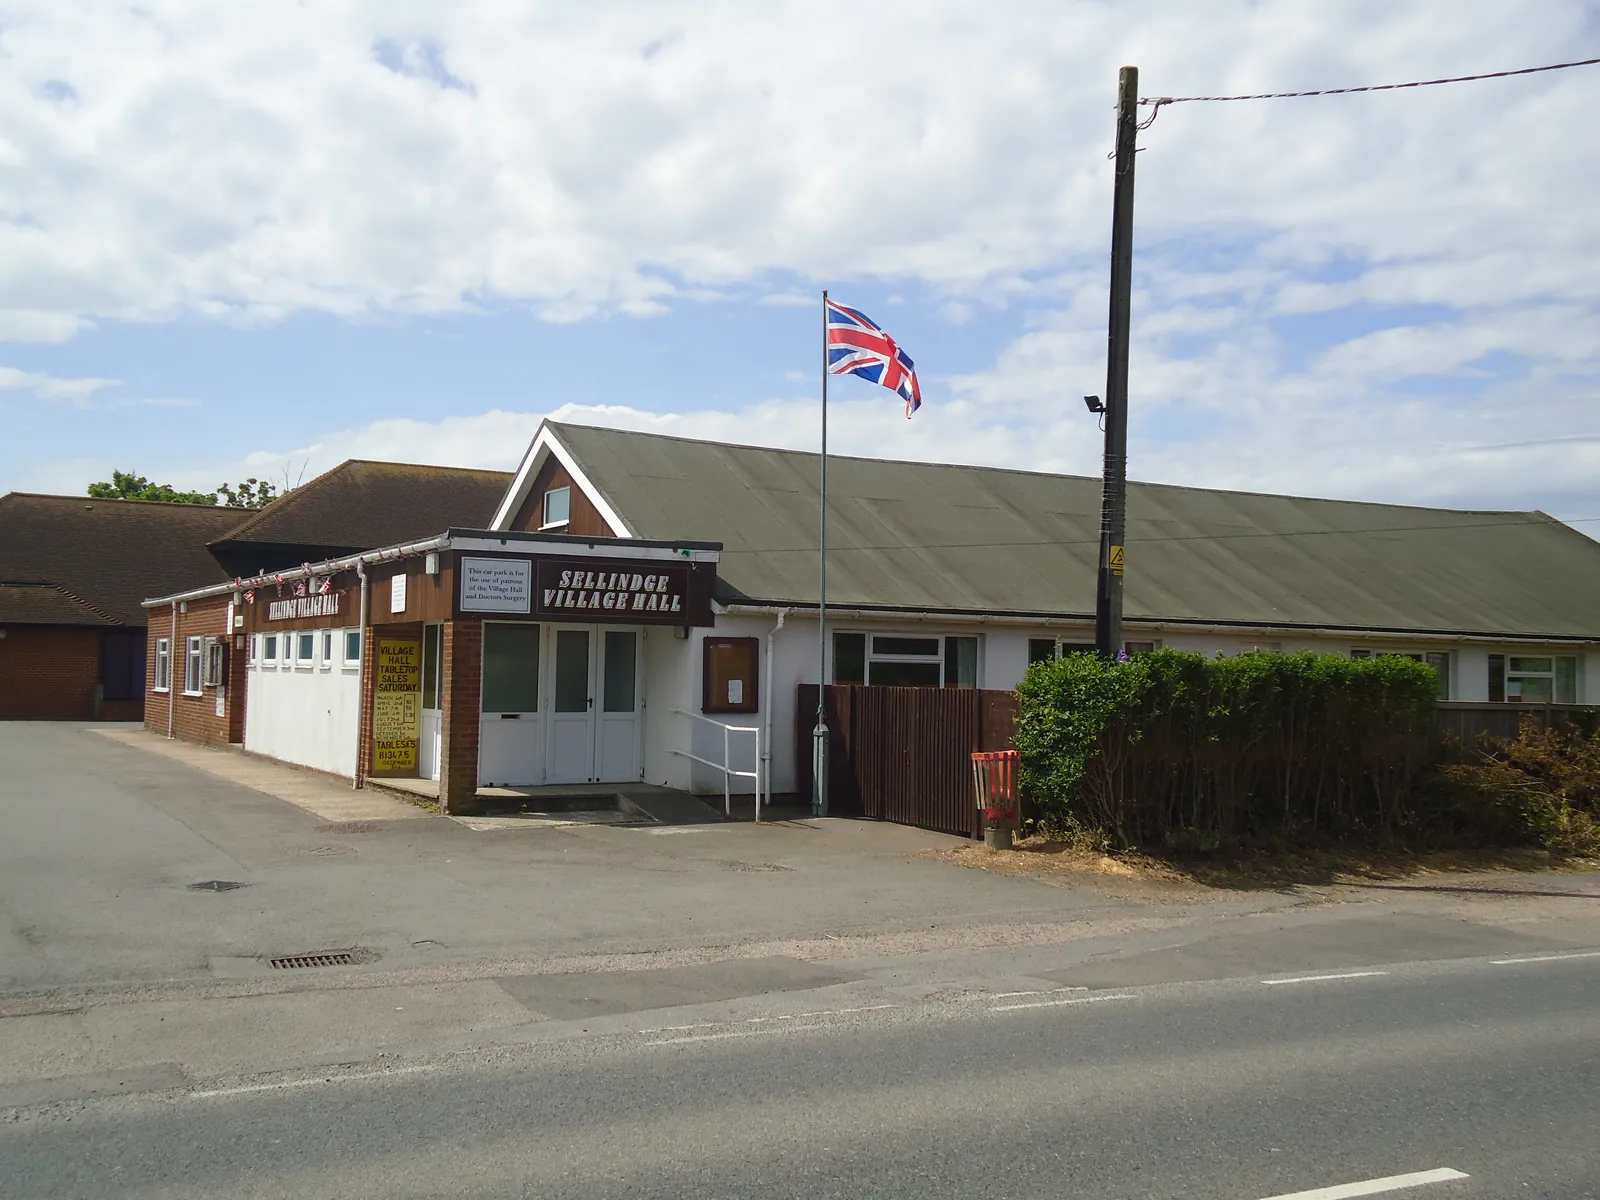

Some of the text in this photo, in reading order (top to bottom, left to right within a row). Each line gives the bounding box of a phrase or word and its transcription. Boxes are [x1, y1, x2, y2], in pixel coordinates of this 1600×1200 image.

[559, 570, 670, 592] SELLINDGE
[543, 589, 681, 612] VILLAGE HALL
[380, 646, 414, 655] VILLAGE
[388, 656, 410, 664] HALL
